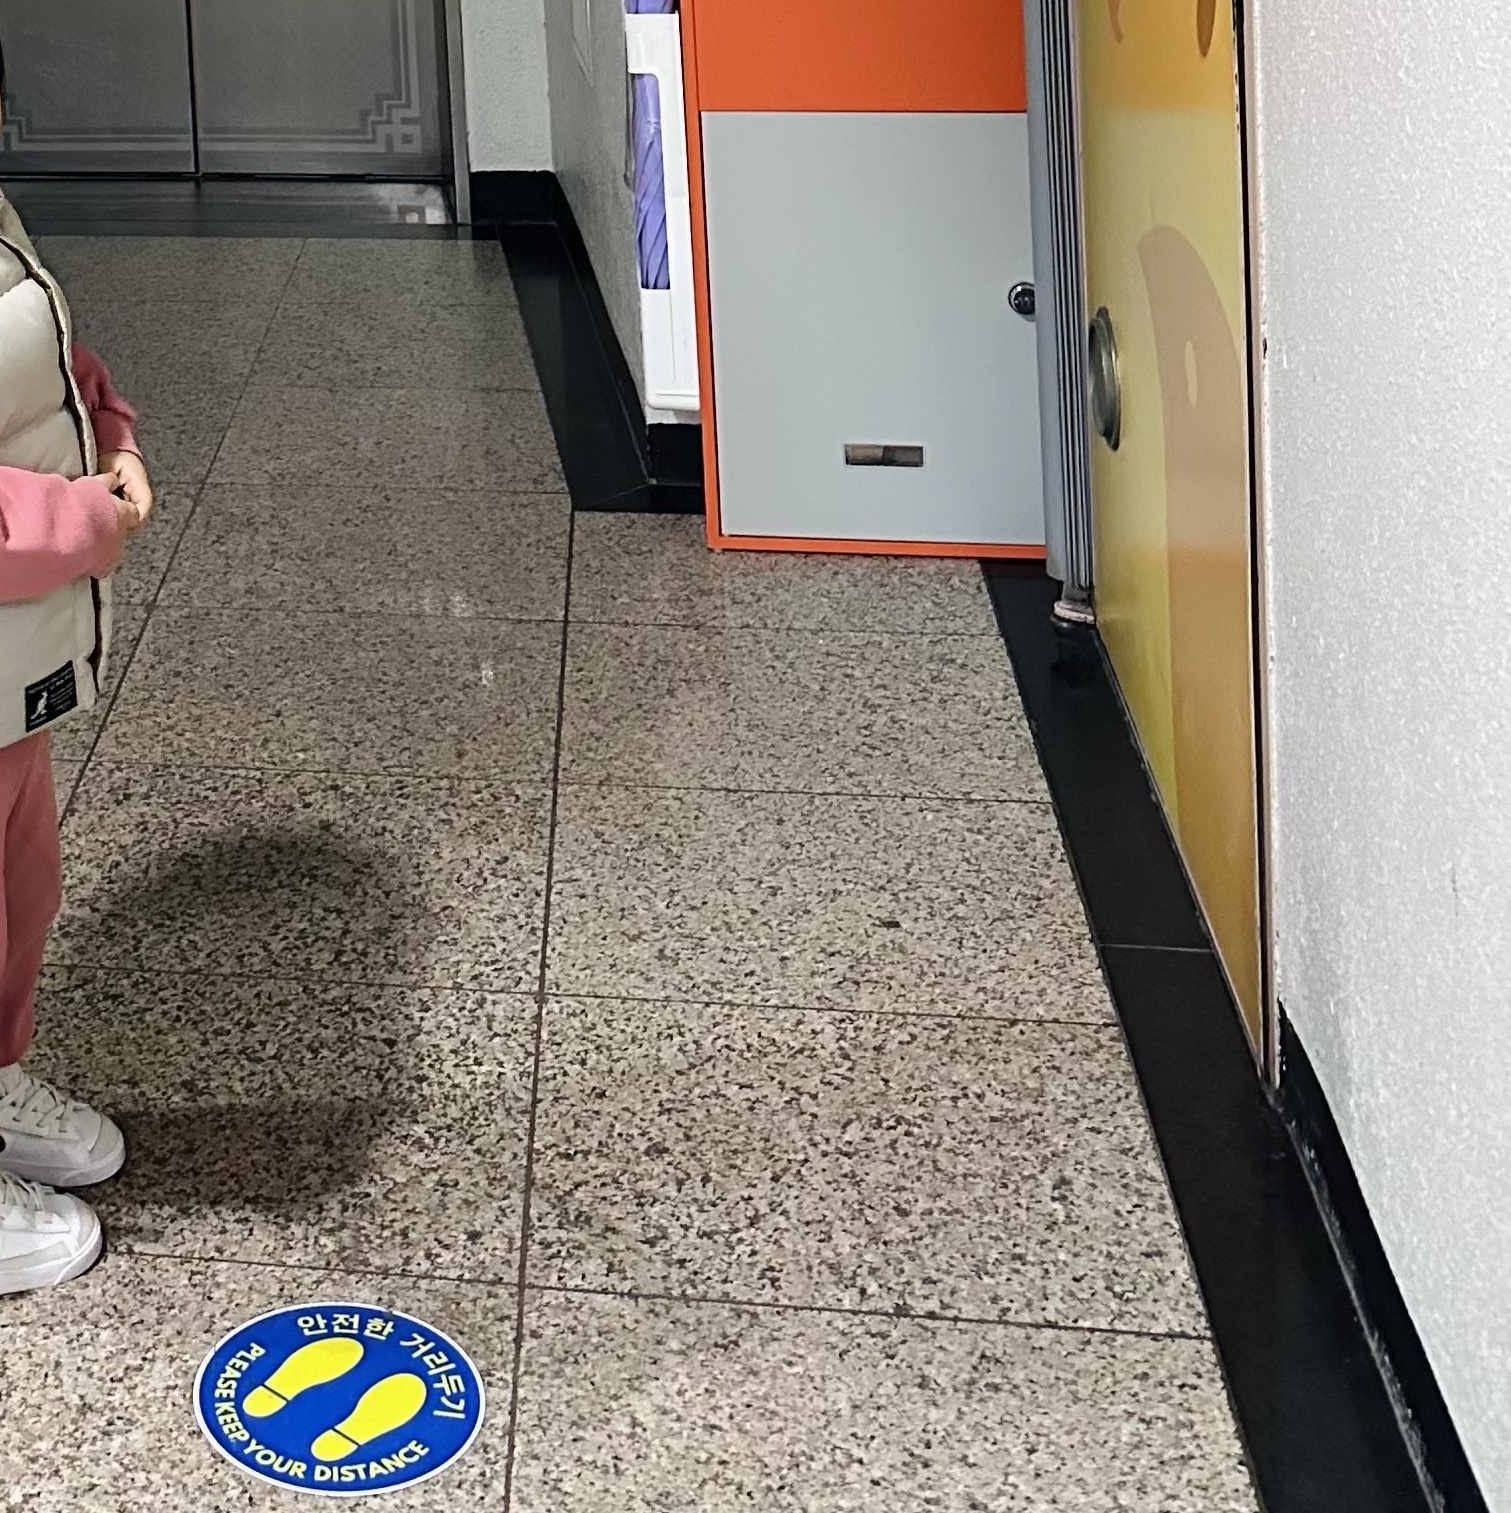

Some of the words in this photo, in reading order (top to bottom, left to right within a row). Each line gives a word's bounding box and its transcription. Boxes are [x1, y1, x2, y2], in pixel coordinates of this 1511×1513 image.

[214, 1342, 266, 1399] PLEASE
[297, 1313, 394, 1340] 안전한
[400, 1333, 465, 1419] 거리두기
[214, 1401, 250, 1442] KEEP
[243, 1439, 307, 1479] YOUR
[314, 1440, 429, 1482] DISTANCE
